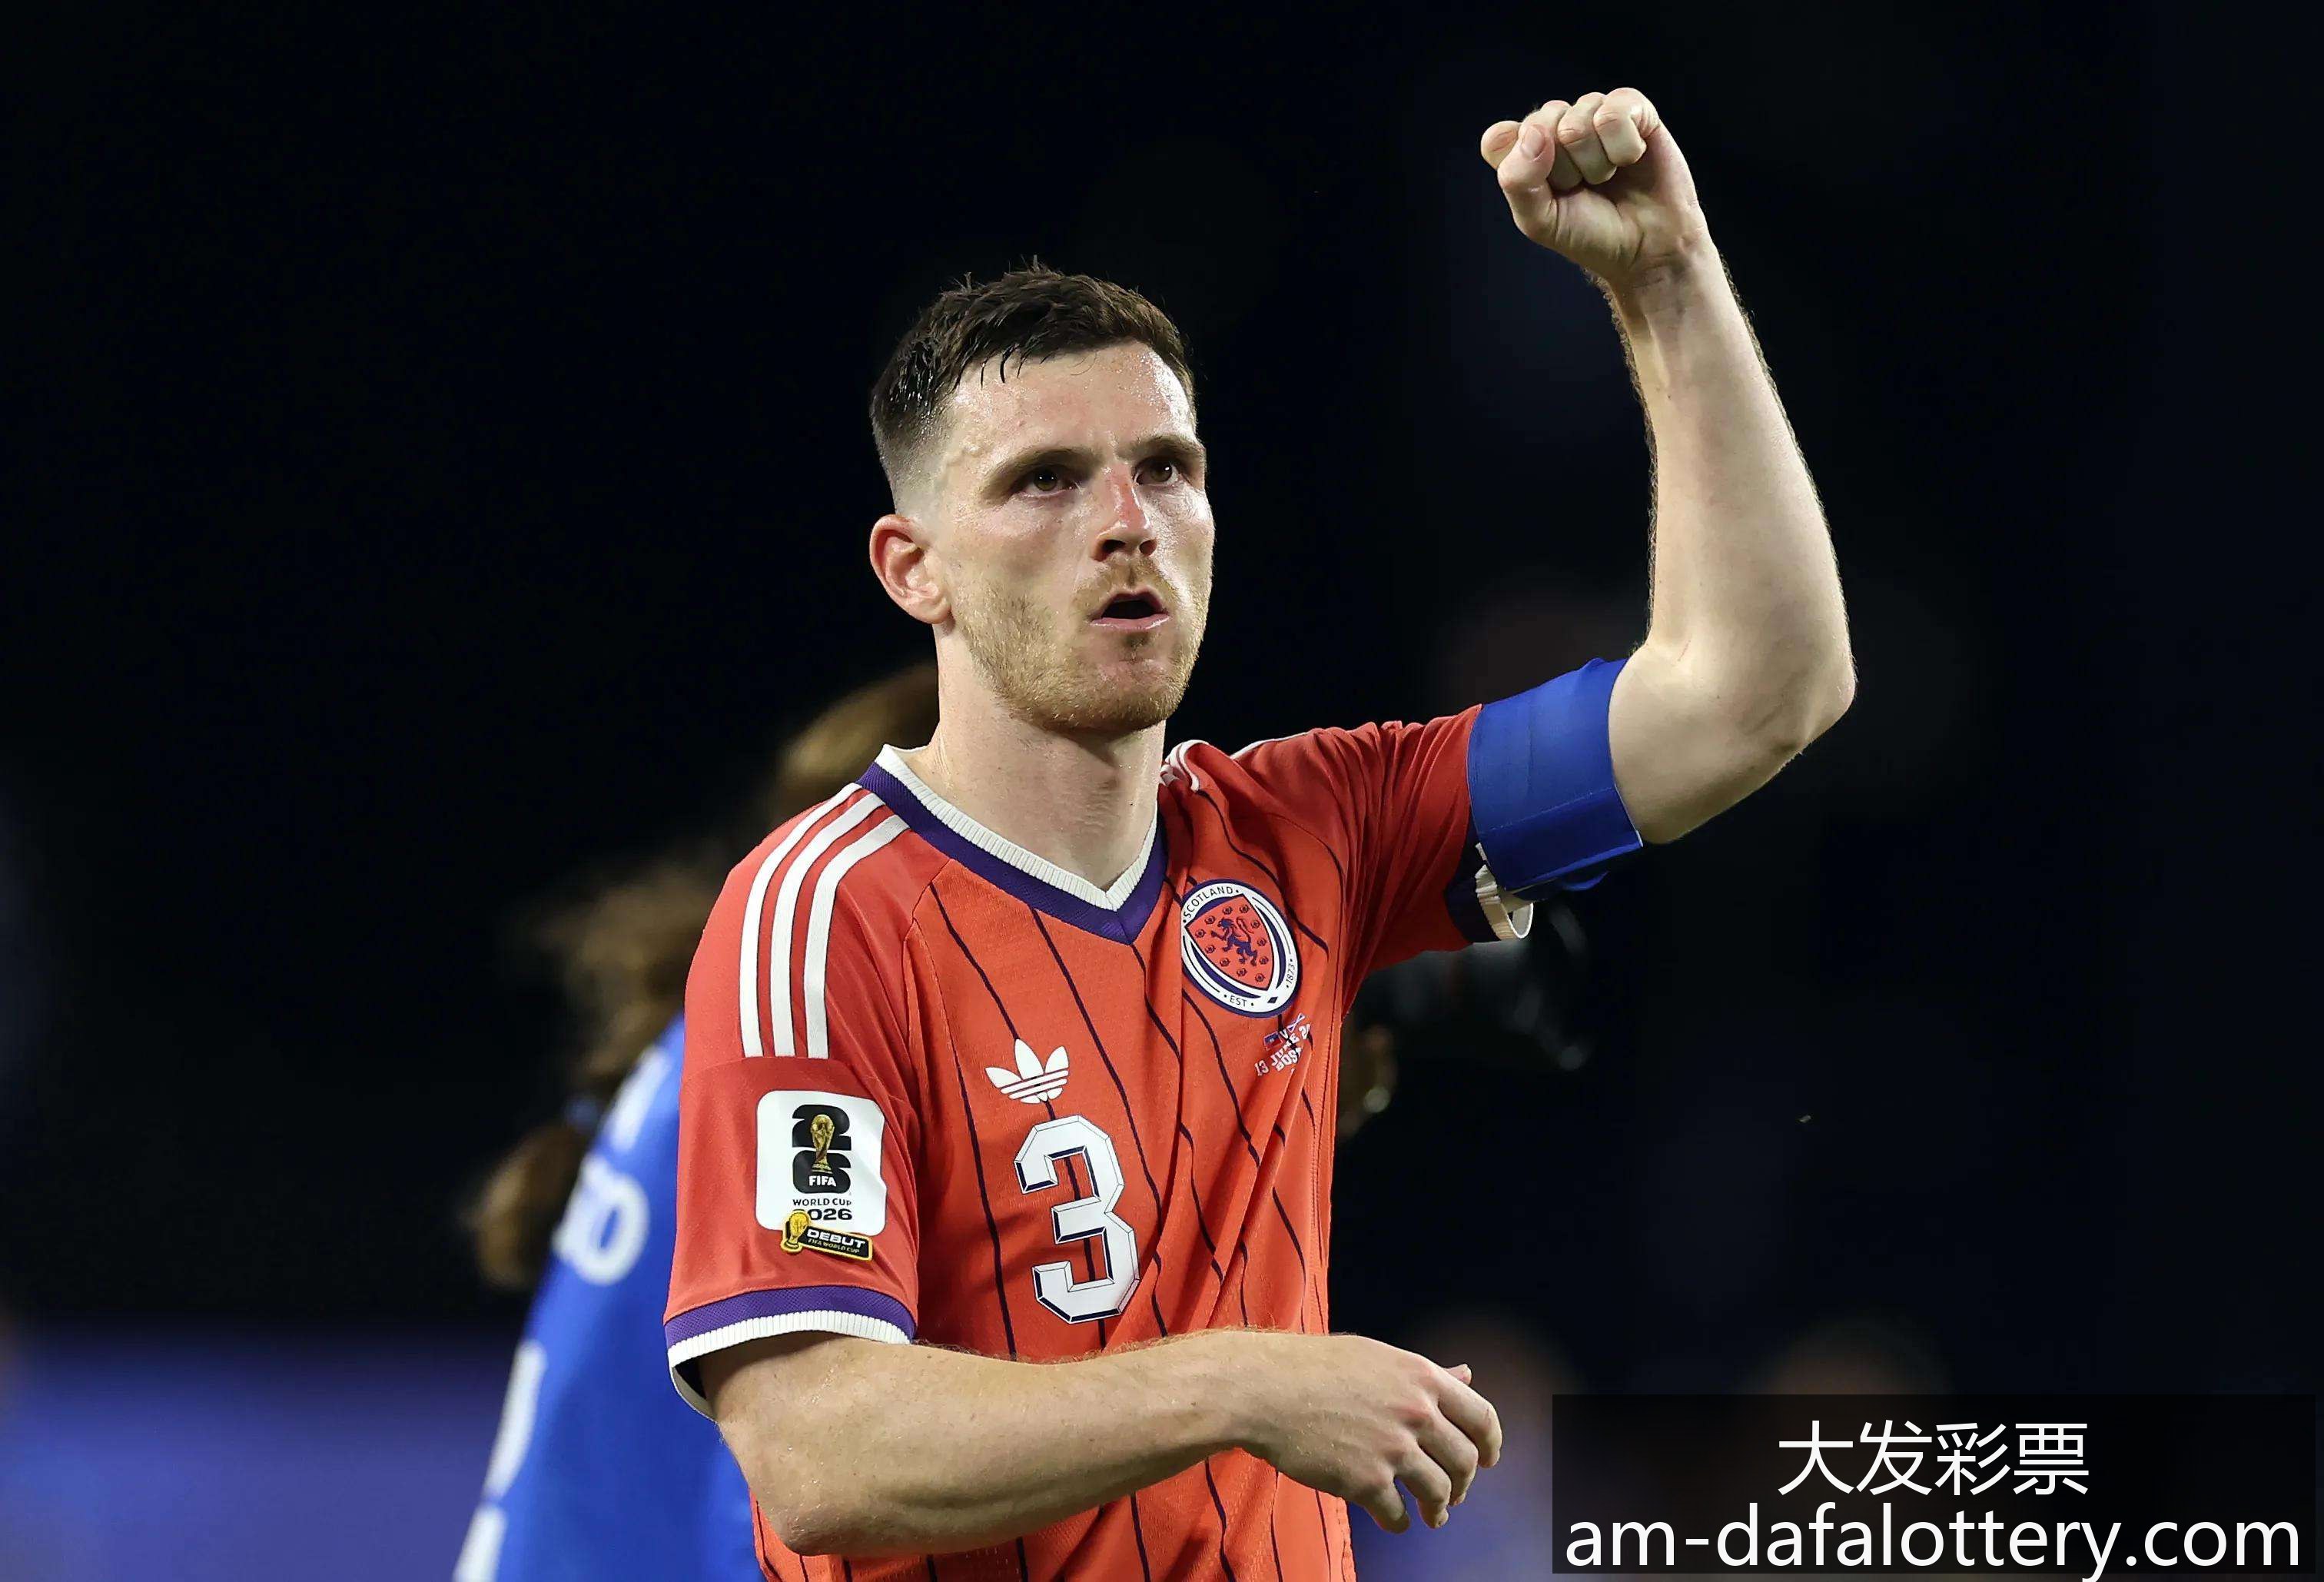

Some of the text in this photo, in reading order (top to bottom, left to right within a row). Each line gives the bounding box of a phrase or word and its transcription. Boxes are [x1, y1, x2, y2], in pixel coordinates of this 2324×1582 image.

[1184, 886, 1233, 919] SCOTLAND
[1286, 963, 1296, 985] 1873
[1230, 996, 1247, 1007] EST
[1254, 1059, 1270, 1076] 13
[808, 1175, 837, 1187] FIFA
[792, 1198, 852, 1206] WORLD CUP
[793, 1208, 853, 1221] 026
[1014, 1115, 1140, 1324] 3
[807, 1228, 865, 1248] DEBUT
[822, 1241, 846, 1251] WORLD
